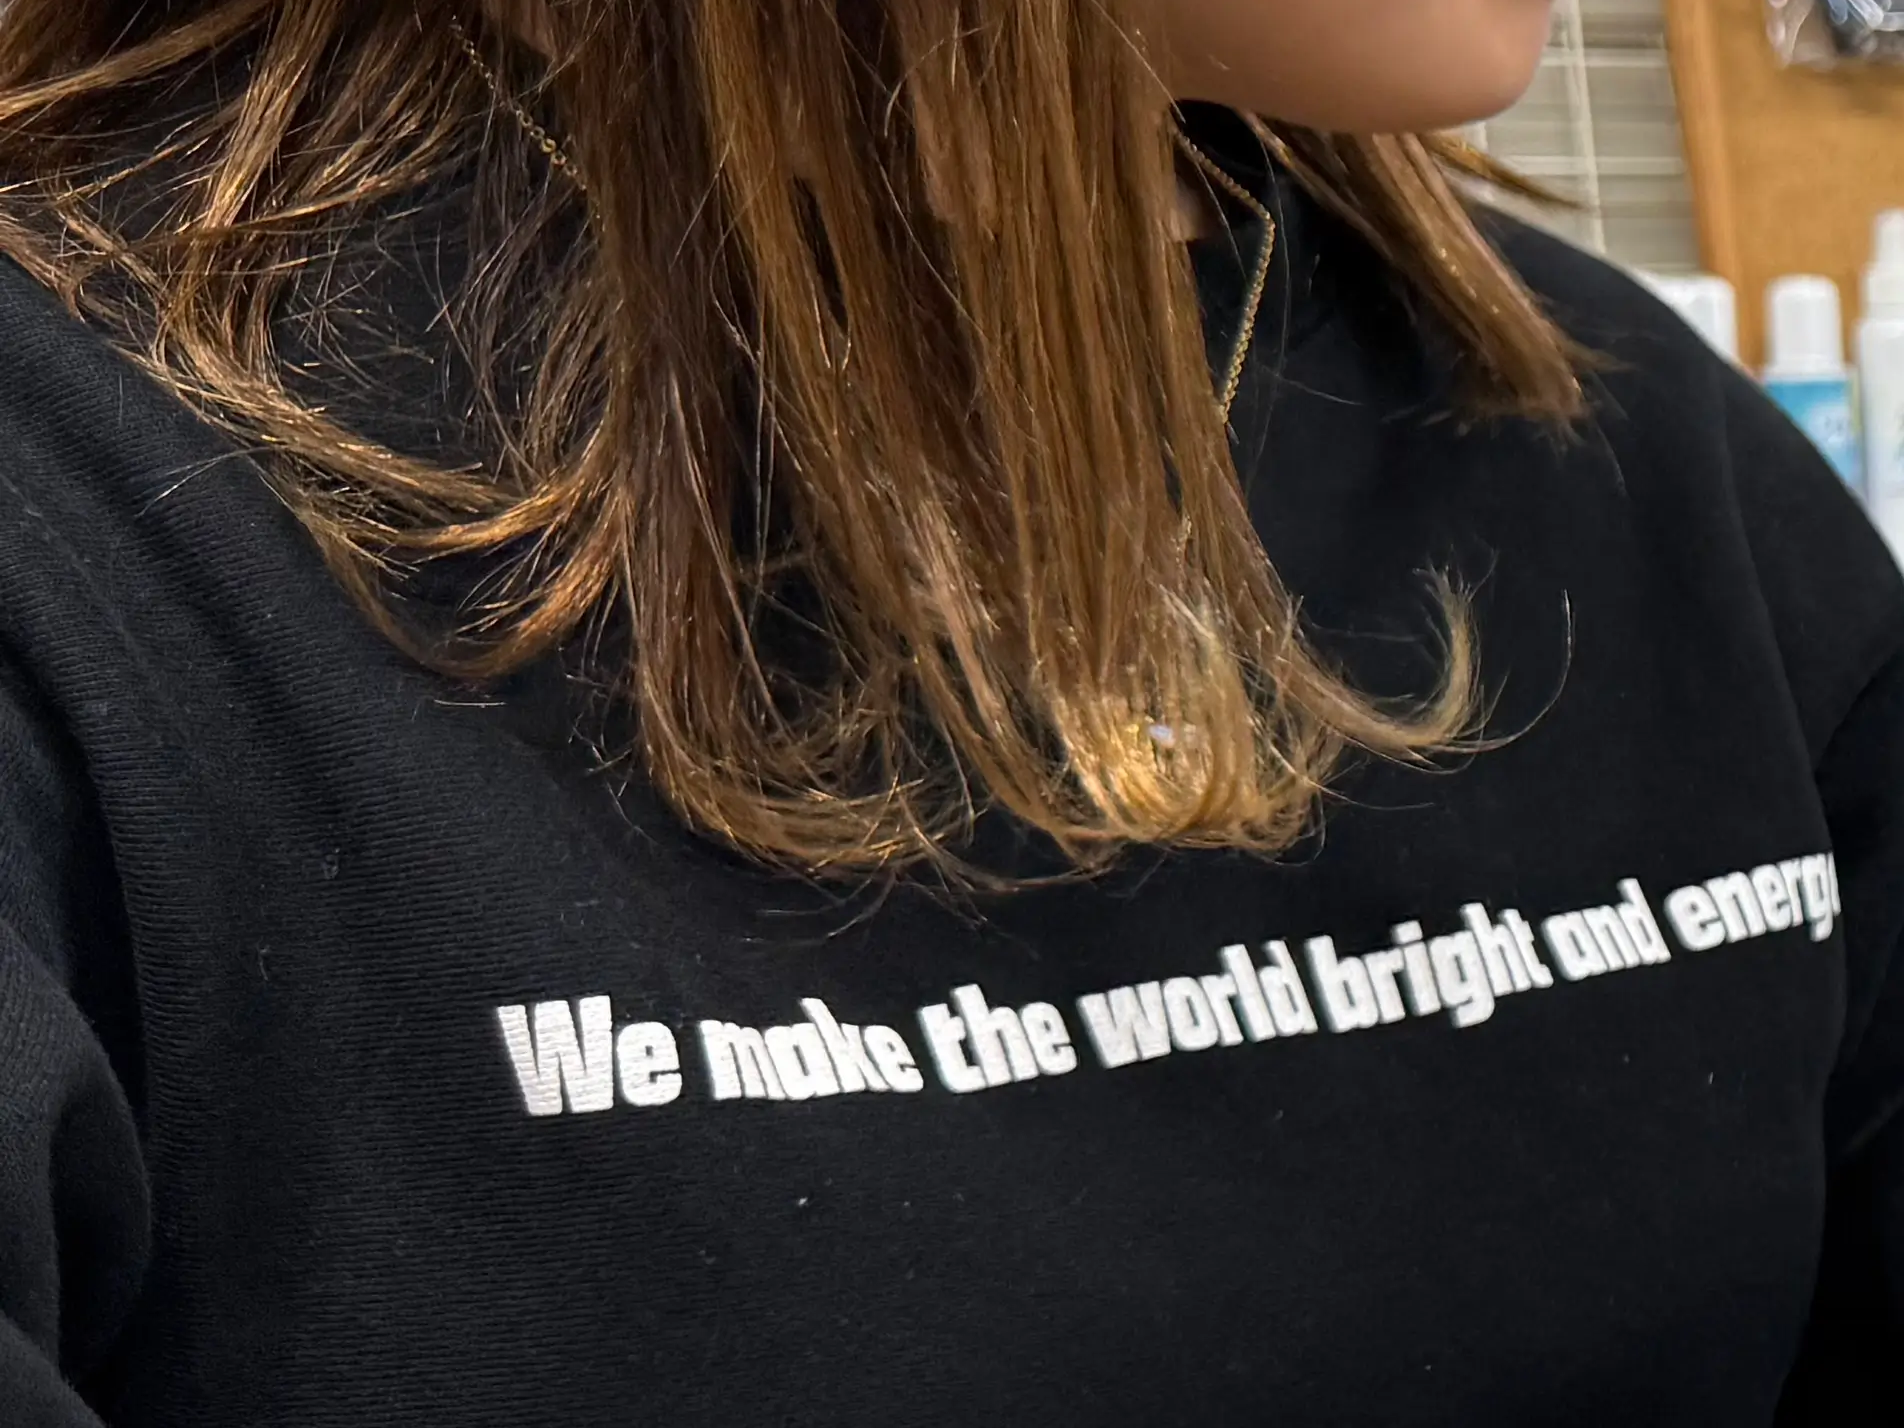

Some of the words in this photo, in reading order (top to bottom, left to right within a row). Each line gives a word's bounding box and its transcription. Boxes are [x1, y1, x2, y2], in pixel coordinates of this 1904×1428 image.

[495, 994, 683, 1117] We
[697, 998, 924, 1102] make
[918, 983, 1076, 1095] the
[1085, 939, 1319, 1070] world
[1311, 902, 1553, 1035] bright
[1552, 879, 1672, 982] and
